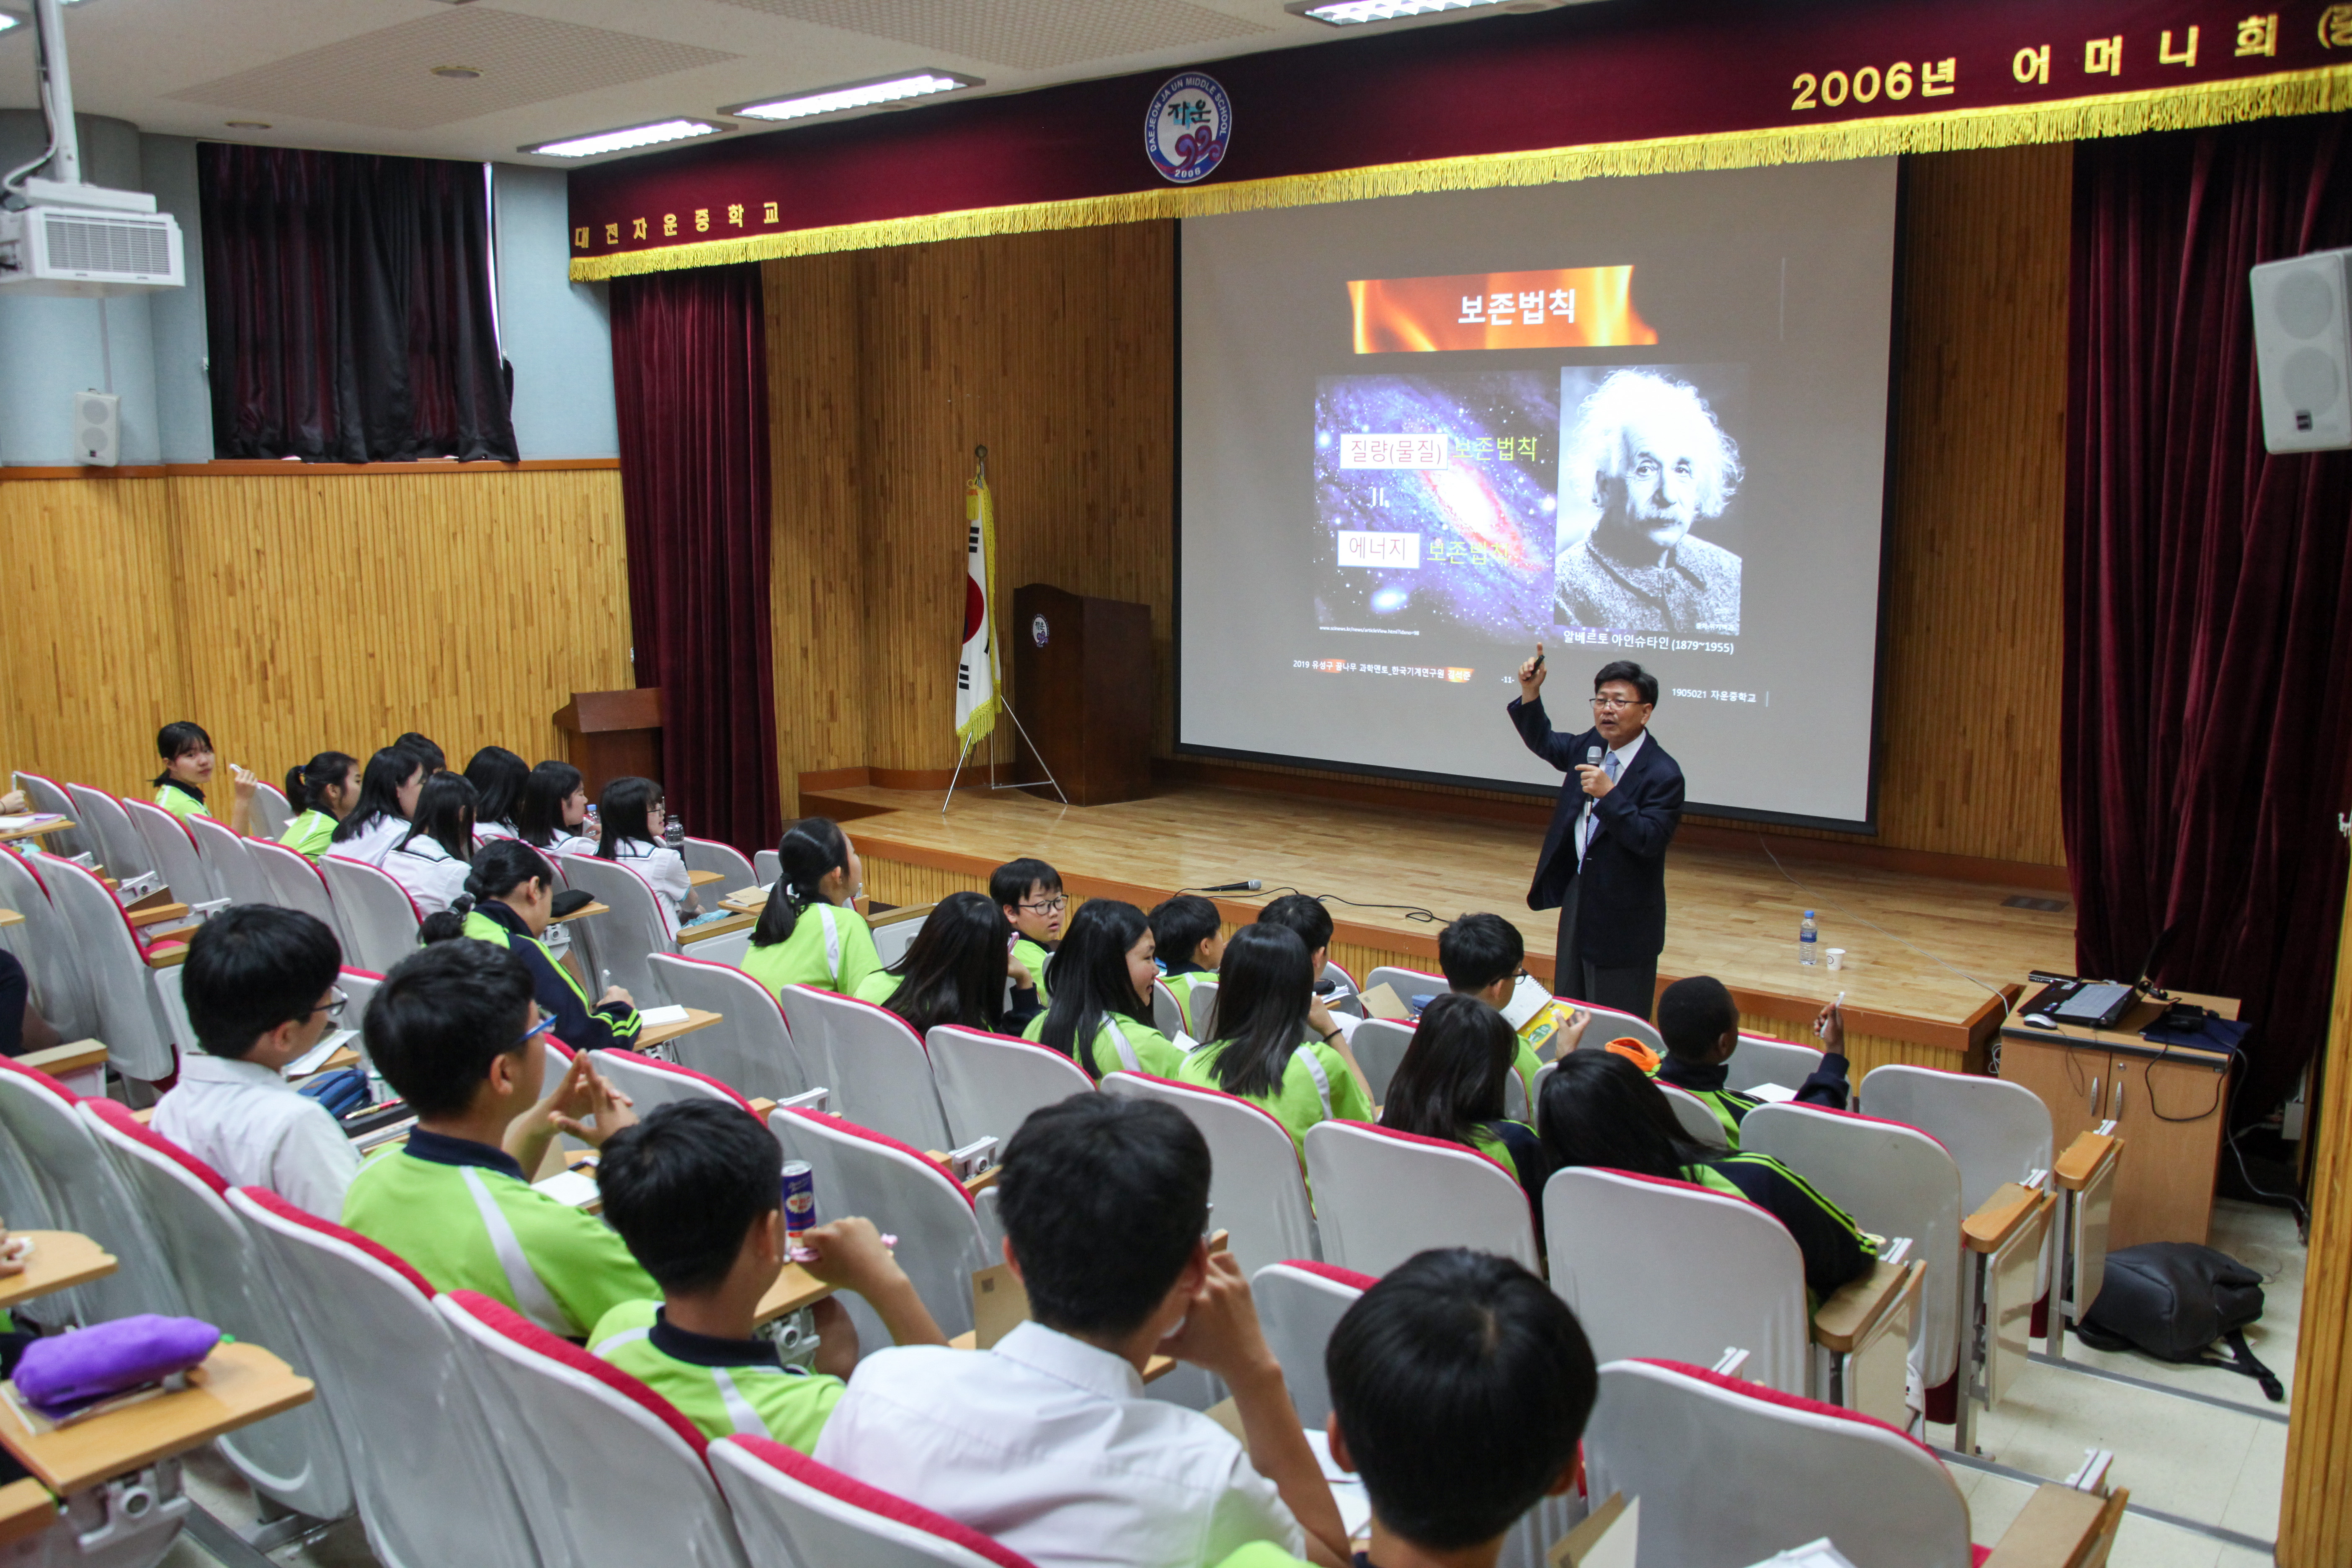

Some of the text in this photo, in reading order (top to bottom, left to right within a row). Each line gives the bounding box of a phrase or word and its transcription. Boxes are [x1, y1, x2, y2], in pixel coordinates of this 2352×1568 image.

[1791, 57, 1956, 111] 2006년
[2013, 13, 2278, 85] 어머니회
[1149, 77, 1228, 152] DAEJEON JA UN MIDDLE SCHOOL
[1168, 99, 1212, 126] 자운
[1175, 168, 1201, 178] 2006
[575, 202, 779, 248] 대전자운중학교
[1458, 289, 1576, 325] 보존법칙
[1351, 436, 1537, 465] 질량(물질) 보존법칙
[1349, 536, 1509, 567] 에너지 보존법칙
[1563, 630, 1734, 655] 알베르토 아인슈타인 (1879~1955)
[1293, 660, 1310, 668] 2019
[1312, 660, 1333, 671] 유성구
[1336, 661, 1357, 672] 꿈나무
[1447, 670, 1471, 681] 김석준
[1672, 688, 1756, 703] 1905021 자운중학교
